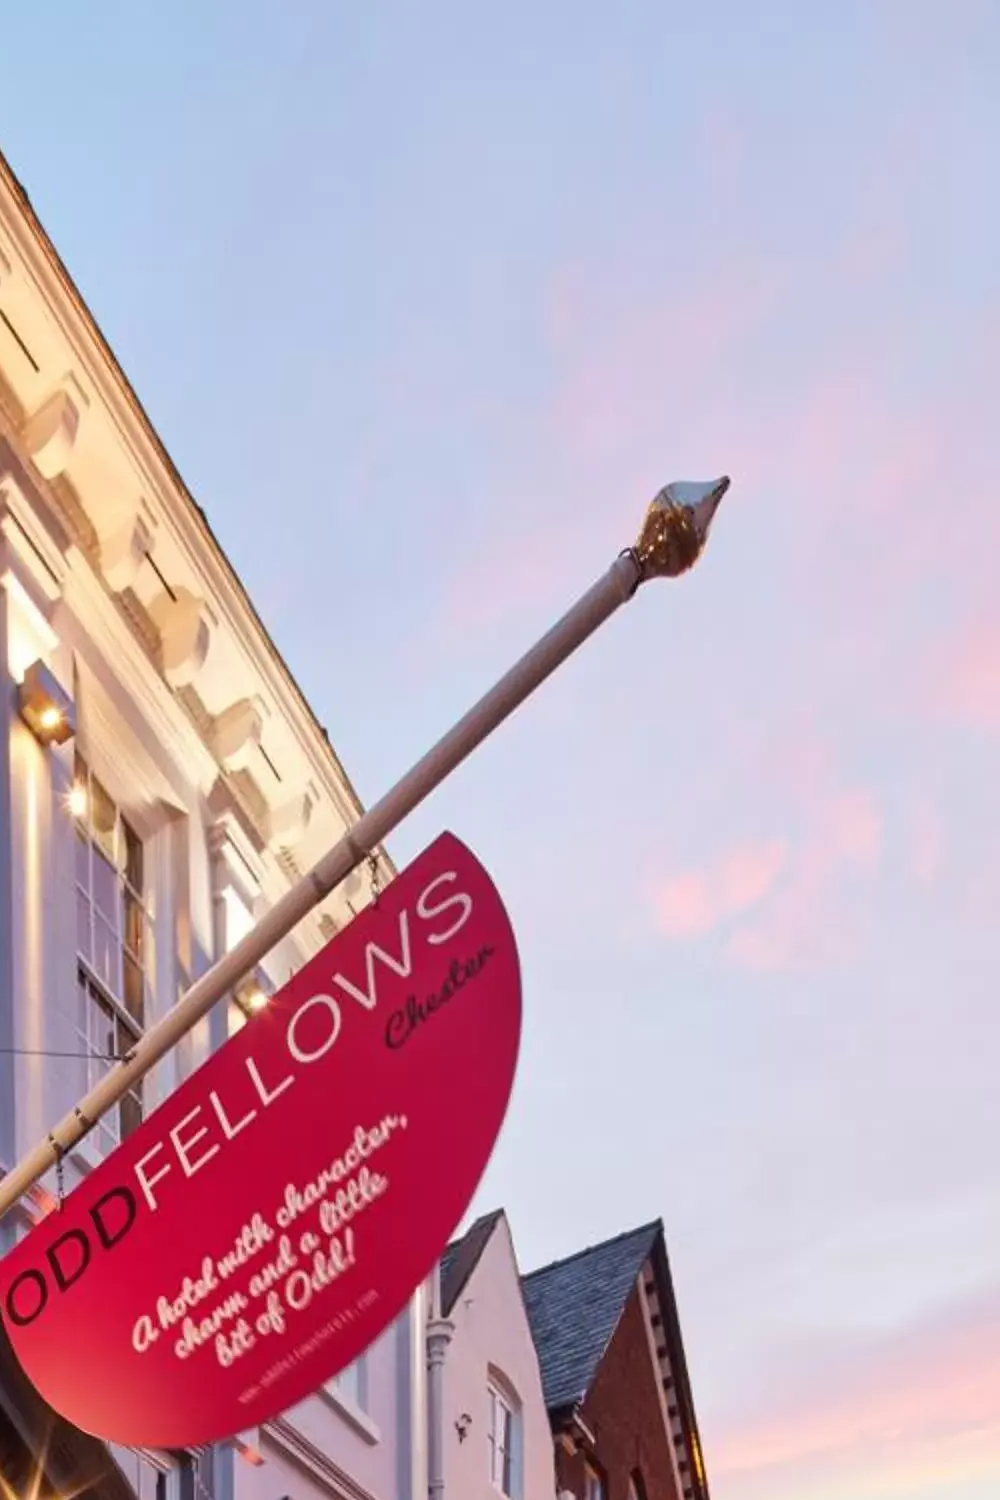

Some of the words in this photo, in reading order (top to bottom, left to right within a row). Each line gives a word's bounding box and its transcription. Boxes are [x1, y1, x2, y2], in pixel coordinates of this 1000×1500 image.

[385, 945, 496, 1050] Chester
[4, 870, 473, 1328] ODDFELLOWS
[131, 1315, 159, 1353] A
[156, 1256, 219, 1330] hotel
[216, 1212, 275, 1280] with
[276, 1114, 408, 1229] character,
[174, 1290, 249, 1360] charm
[249, 1234, 298, 1298] and
[299, 1231, 321, 1255] a
[319, 1165, 388, 1235] little
[215, 1318, 257, 1368] bit
[255, 1290, 286, 1335] of
[285, 1226, 356, 1311] Odd!
